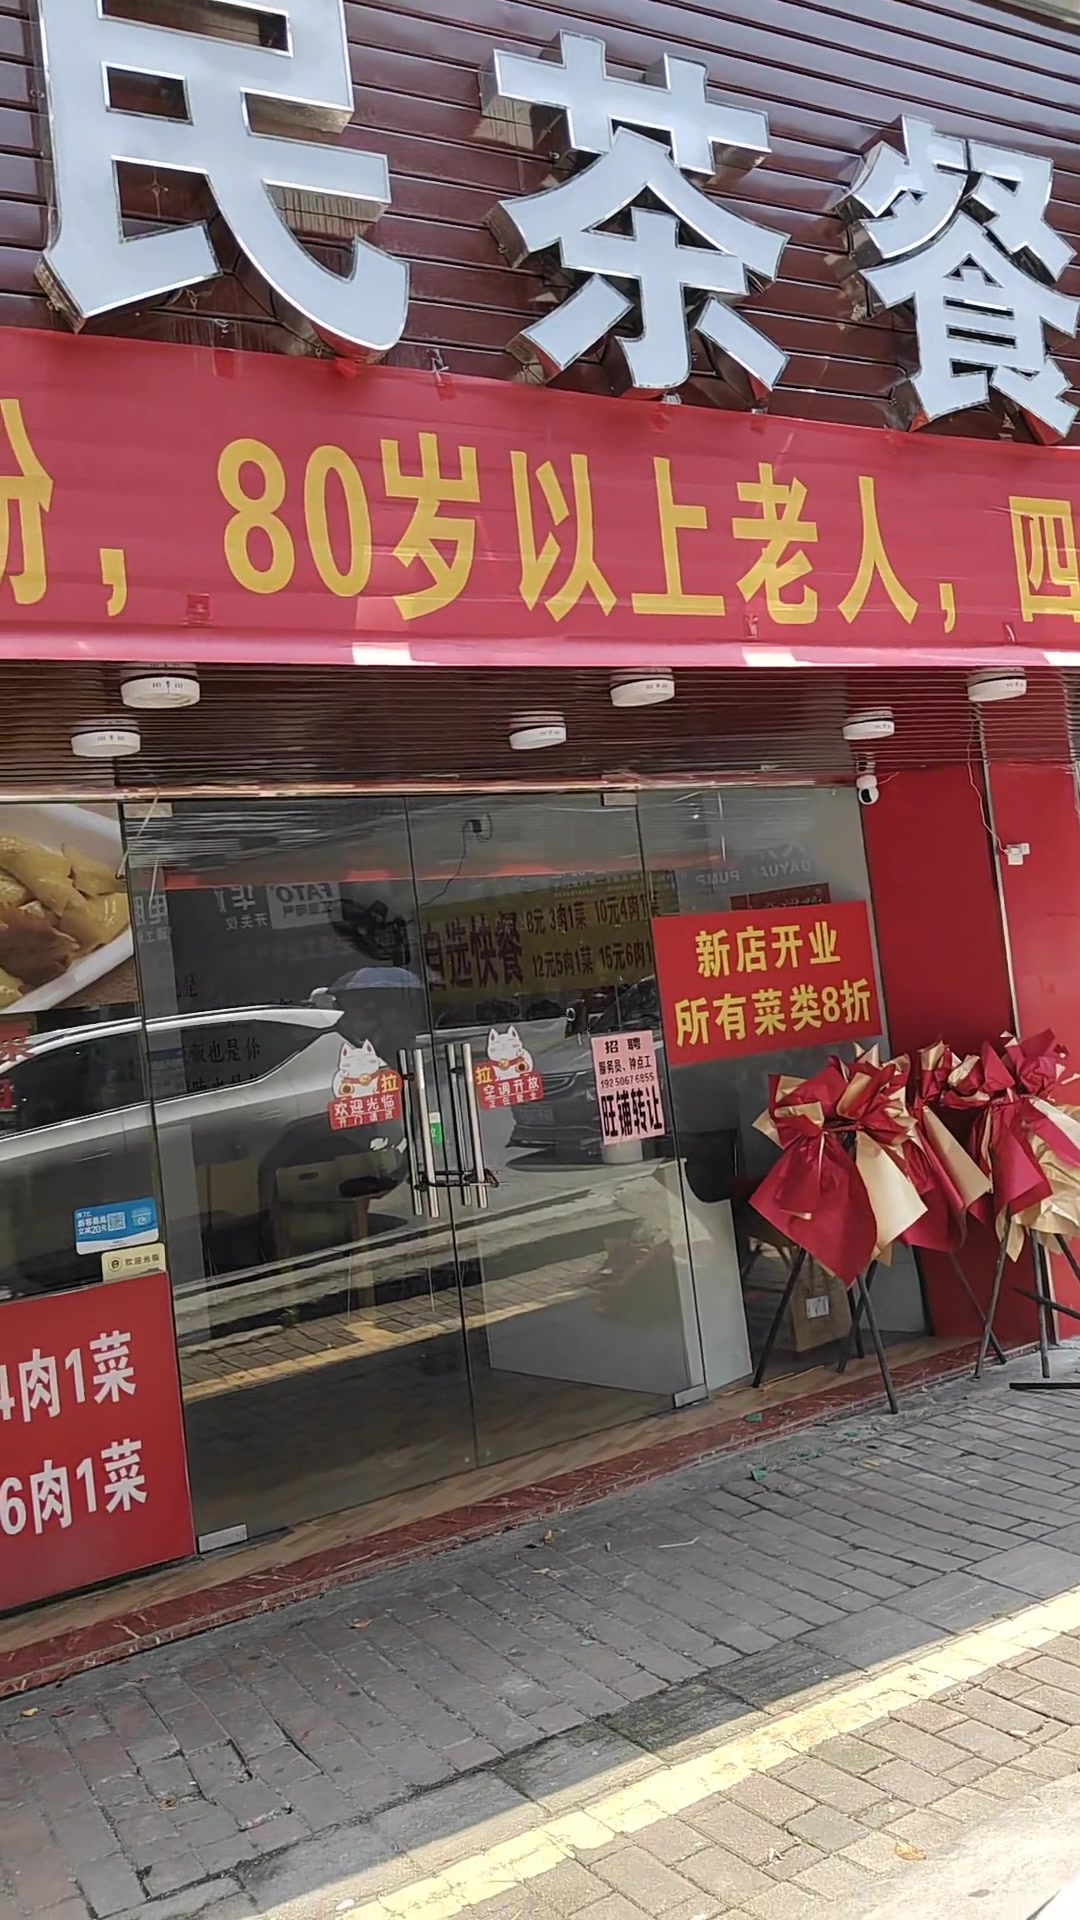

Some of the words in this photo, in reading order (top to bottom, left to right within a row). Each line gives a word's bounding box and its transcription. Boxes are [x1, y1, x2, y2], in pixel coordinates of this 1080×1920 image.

[40, 0, 1080, 438] 民茶餐
[695, 921, 841, 978] 新店开业
[674, 978, 871, 1047] 所有菜类8折
[381, 1073, 399, 1093] 拉
[475, 1065, 493, 1085] 拉
[483, 1076, 540, 1101] 空调开放
[333, 1094, 395, 1118] 欢迎光临
[601, 1085, 663, 1138] 旺铺转让
[0, 1438, 147, 1536] 6肉1菜
